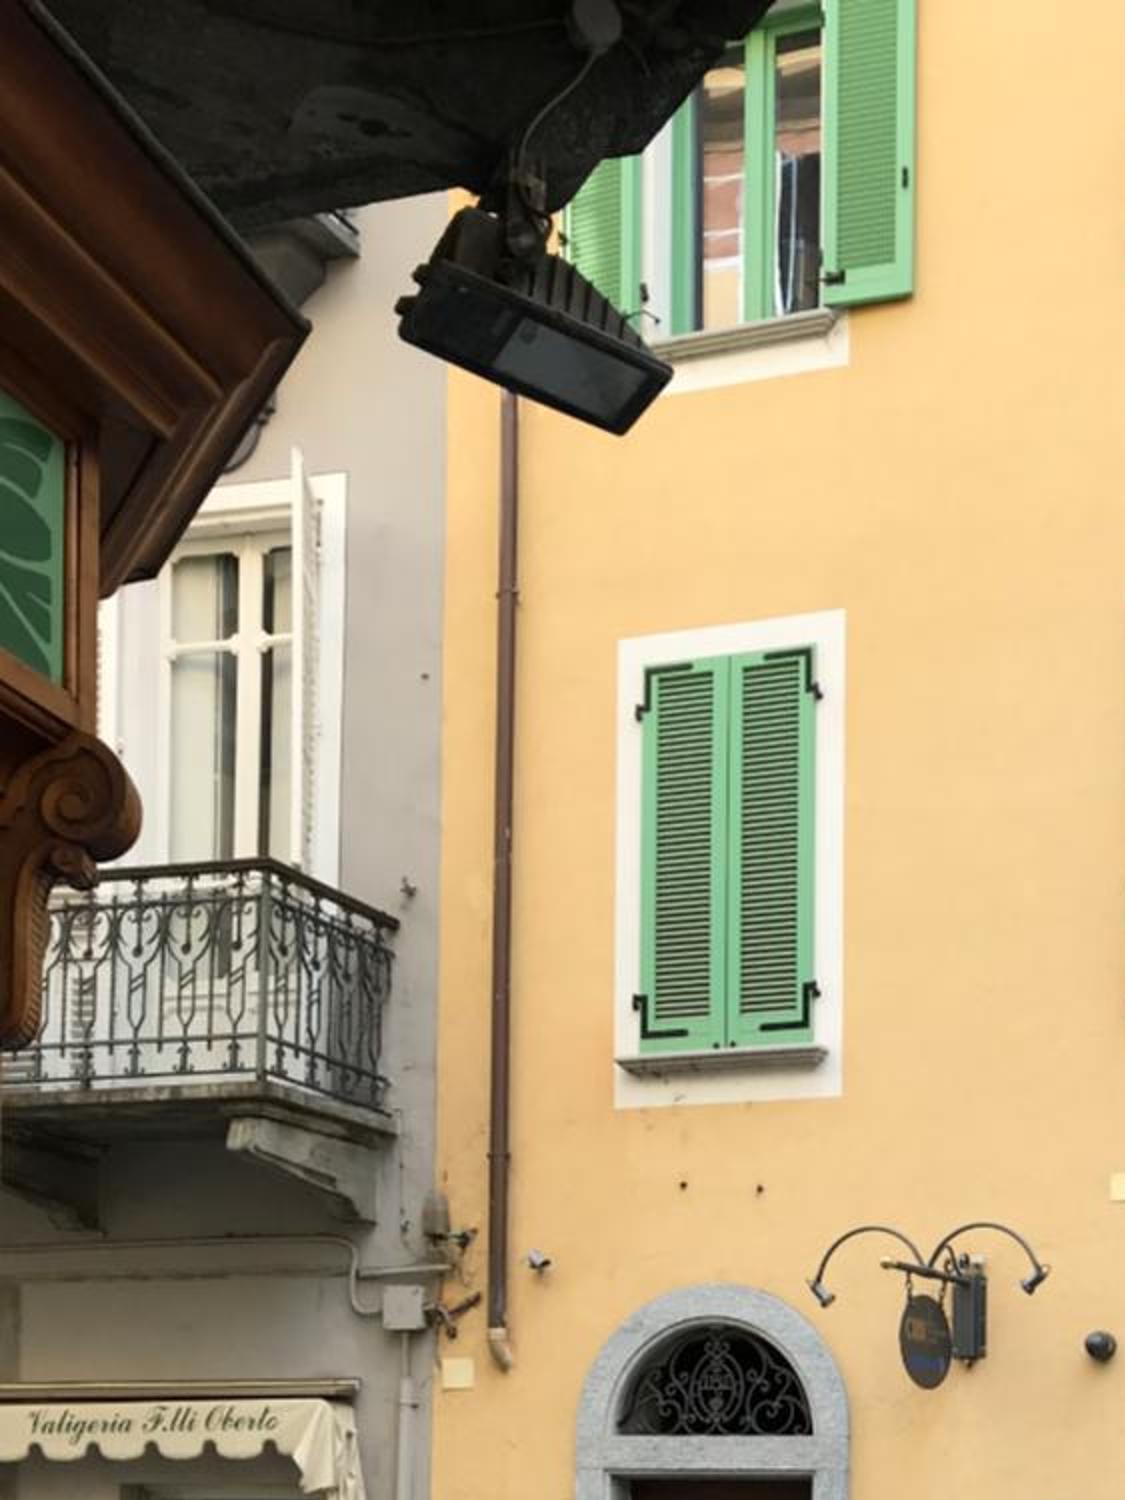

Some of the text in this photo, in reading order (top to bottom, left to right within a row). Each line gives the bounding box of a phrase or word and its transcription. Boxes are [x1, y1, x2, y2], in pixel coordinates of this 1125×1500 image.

[29, 1404, 279, 1446] Valigeria F.lli Oberto
